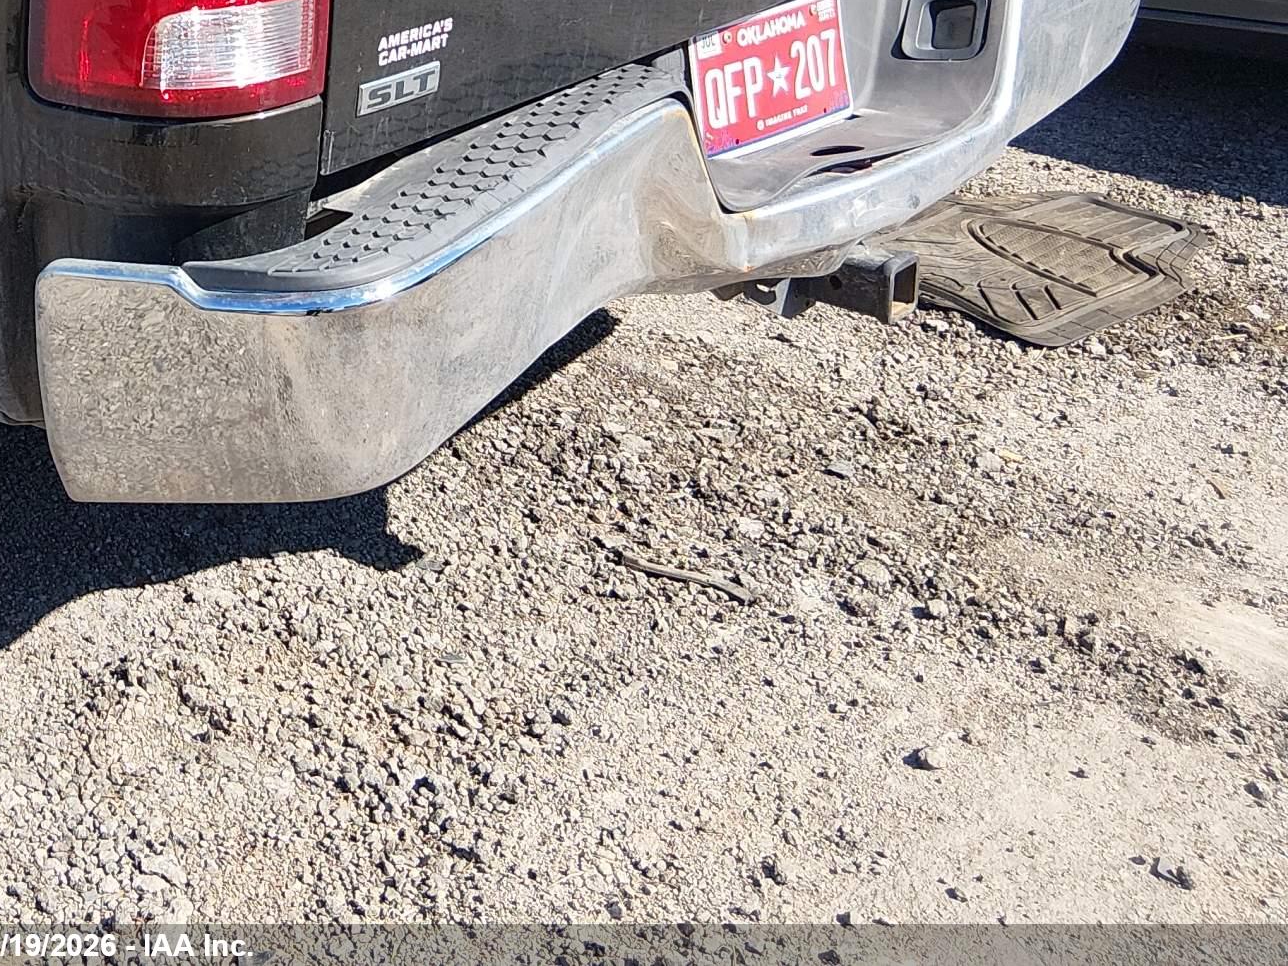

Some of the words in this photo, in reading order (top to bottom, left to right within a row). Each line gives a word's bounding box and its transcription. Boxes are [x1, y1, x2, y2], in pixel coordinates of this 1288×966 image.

[377, 17, 453, 52] AMERICA'S
[736, 10, 807, 47] OKLAHOMA
[378, 33, 449, 67] CAR-MART
[366, 70, 436, 109] SLT
[704, 56, 764, 130] QFP
[790, 28, 836, 100] 207
